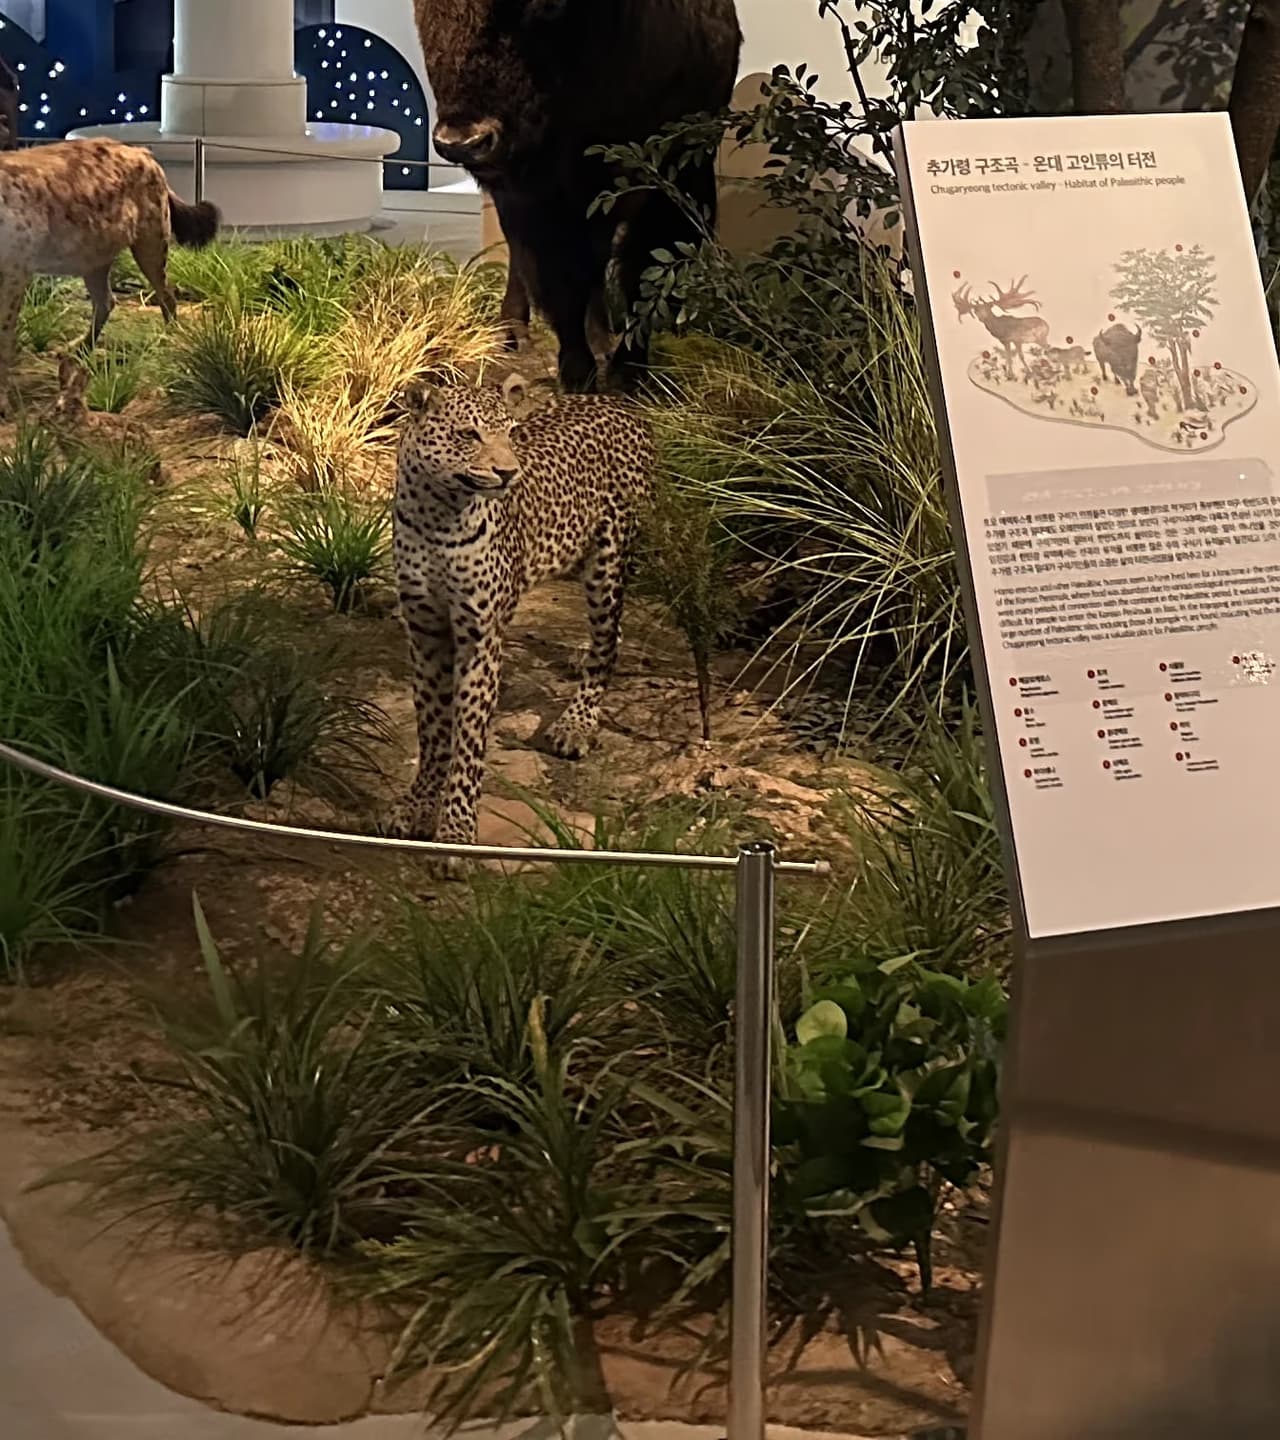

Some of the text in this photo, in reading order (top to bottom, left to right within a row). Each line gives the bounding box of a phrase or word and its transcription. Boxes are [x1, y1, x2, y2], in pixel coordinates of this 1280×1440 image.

[926, 158, 971, 176] 추가령
[974, 156, 1020, 175] 구조곡
[1033, 154, 1063, 172] 온대
[1066, 152, 1124, 171] 고인류의
[1127, 151, 1157, 169] 터전
[930, 183, 991, 195] Chugaryeong
[992, 181, 1029, 192] tectonic
[1030, 180, 1056, 191] valley
[1064, 178, 1098, 189] Habitat
[1099, 177, 1108, 188] of
[1155, 175, 1186, 187] people
